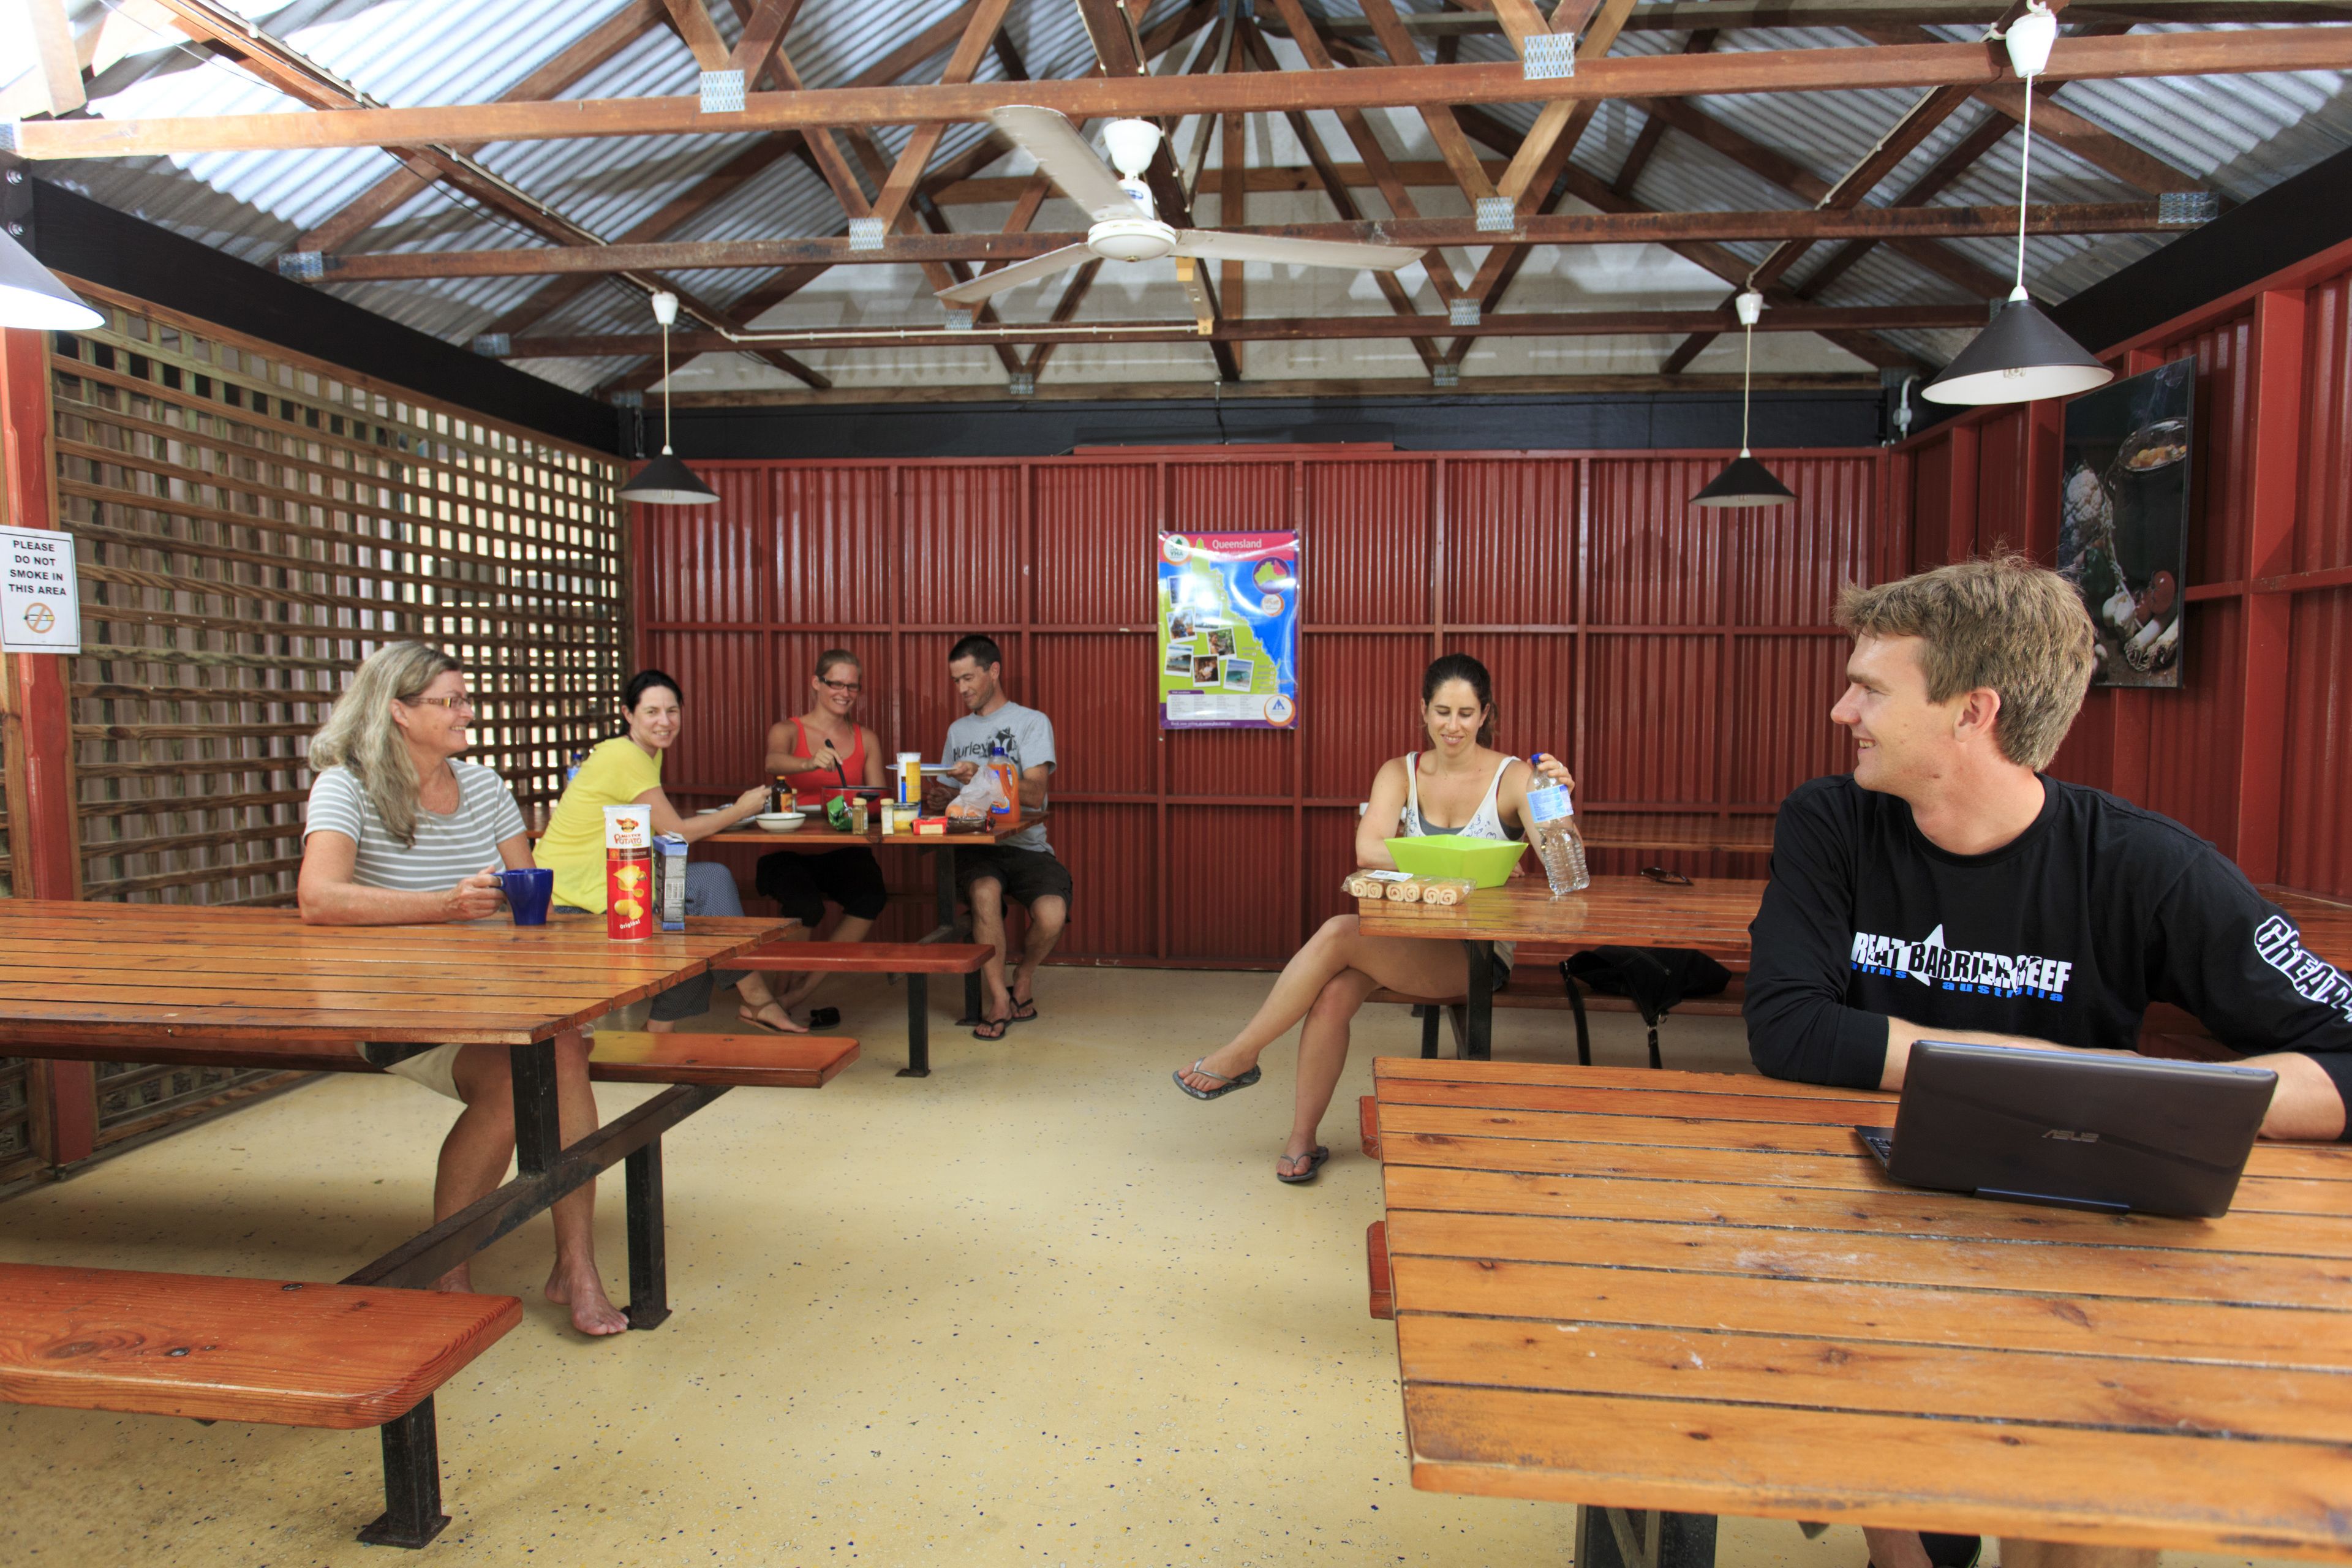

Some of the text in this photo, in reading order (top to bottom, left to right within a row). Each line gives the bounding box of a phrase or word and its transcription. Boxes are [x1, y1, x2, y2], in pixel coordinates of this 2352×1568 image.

[13, 540, 55, 552] PLEASE
[1212, 538, 1262, 550] Queensland
[15, 555, 56, 567] DO NOT
[10, 569, 64, 581] SMOKE IN
[9, 584, 67, 595] THIS AREA
[953, 741, 988, 761] Hurley
[614, 834, 642, 844] POTATO
[619, 919, 641, 929] Original
[1850, 932, 2072, 993] REAT BARRIER REEF
[1942, 981, 2063, 1002] australia
[2041, 1129, 2099, 1143] ASUS
